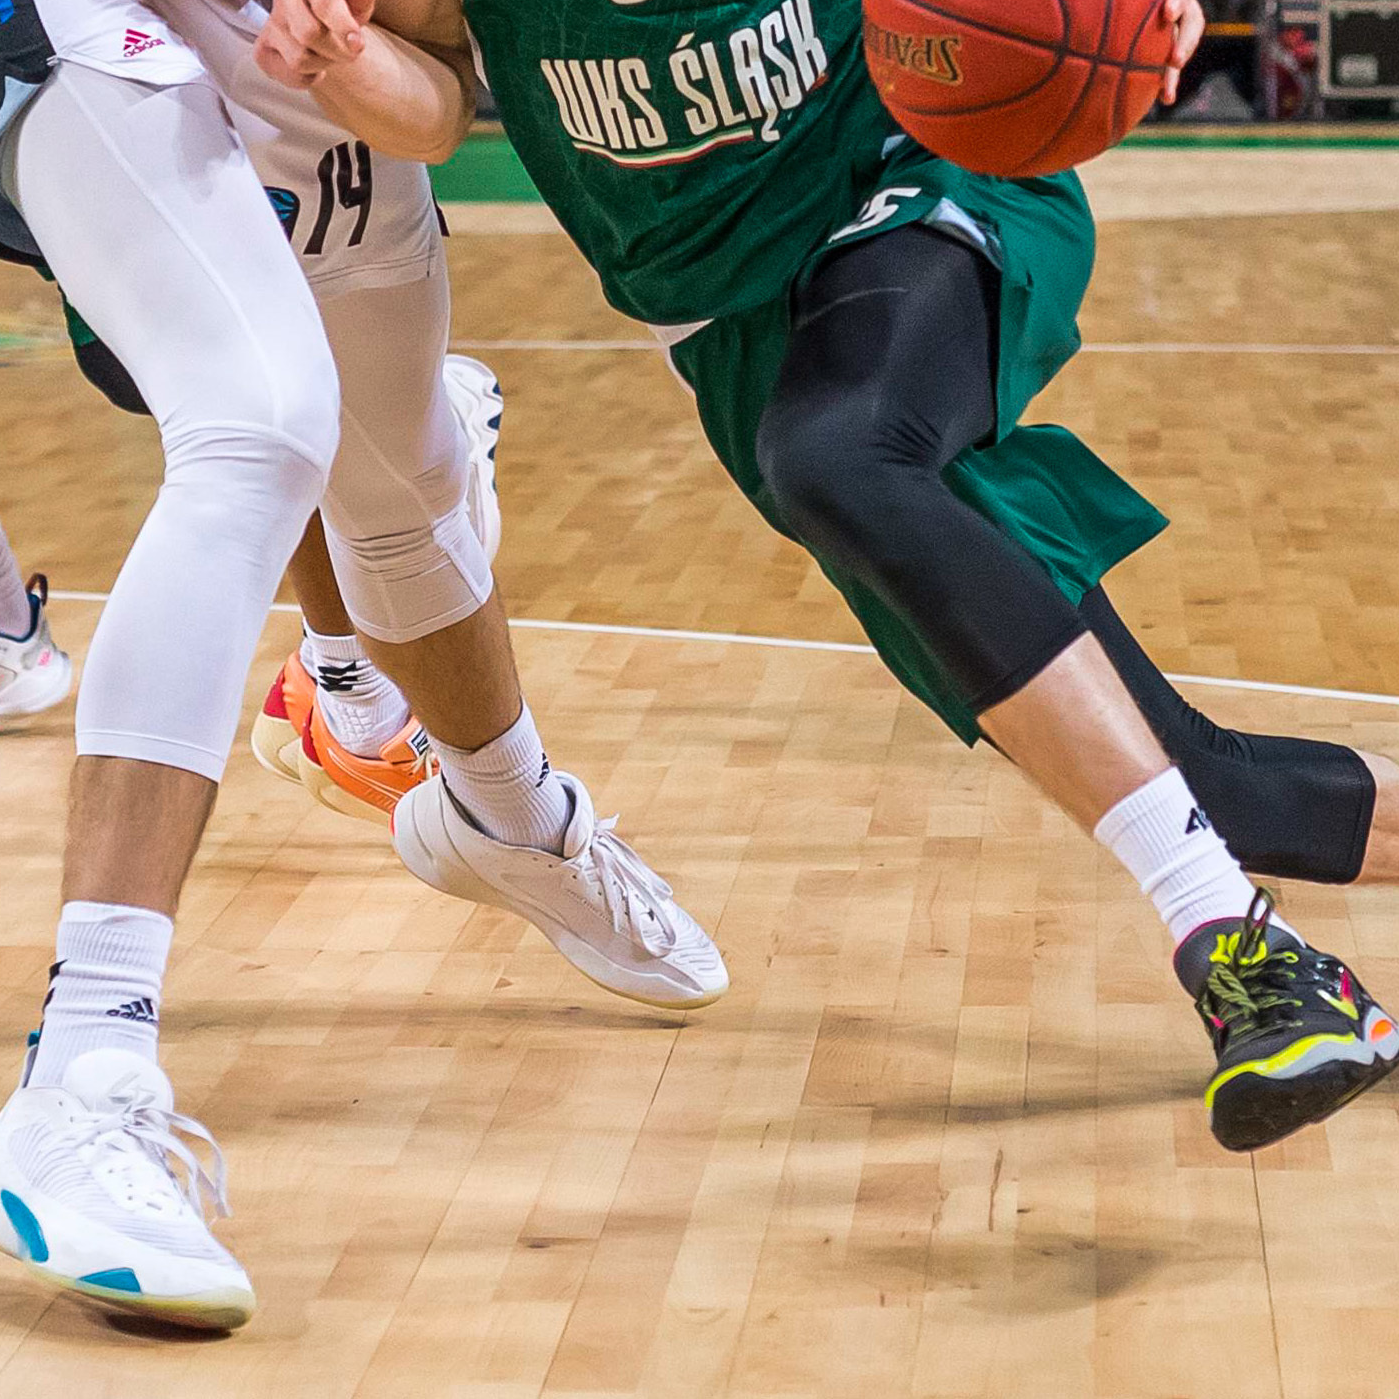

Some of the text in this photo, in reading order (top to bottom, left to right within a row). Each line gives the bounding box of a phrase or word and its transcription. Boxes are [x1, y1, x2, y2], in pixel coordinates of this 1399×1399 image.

[124, 38, 166, 58] adidas
[540, 57, 668, 149] WKS
[303, 140, 372, 255] 14
